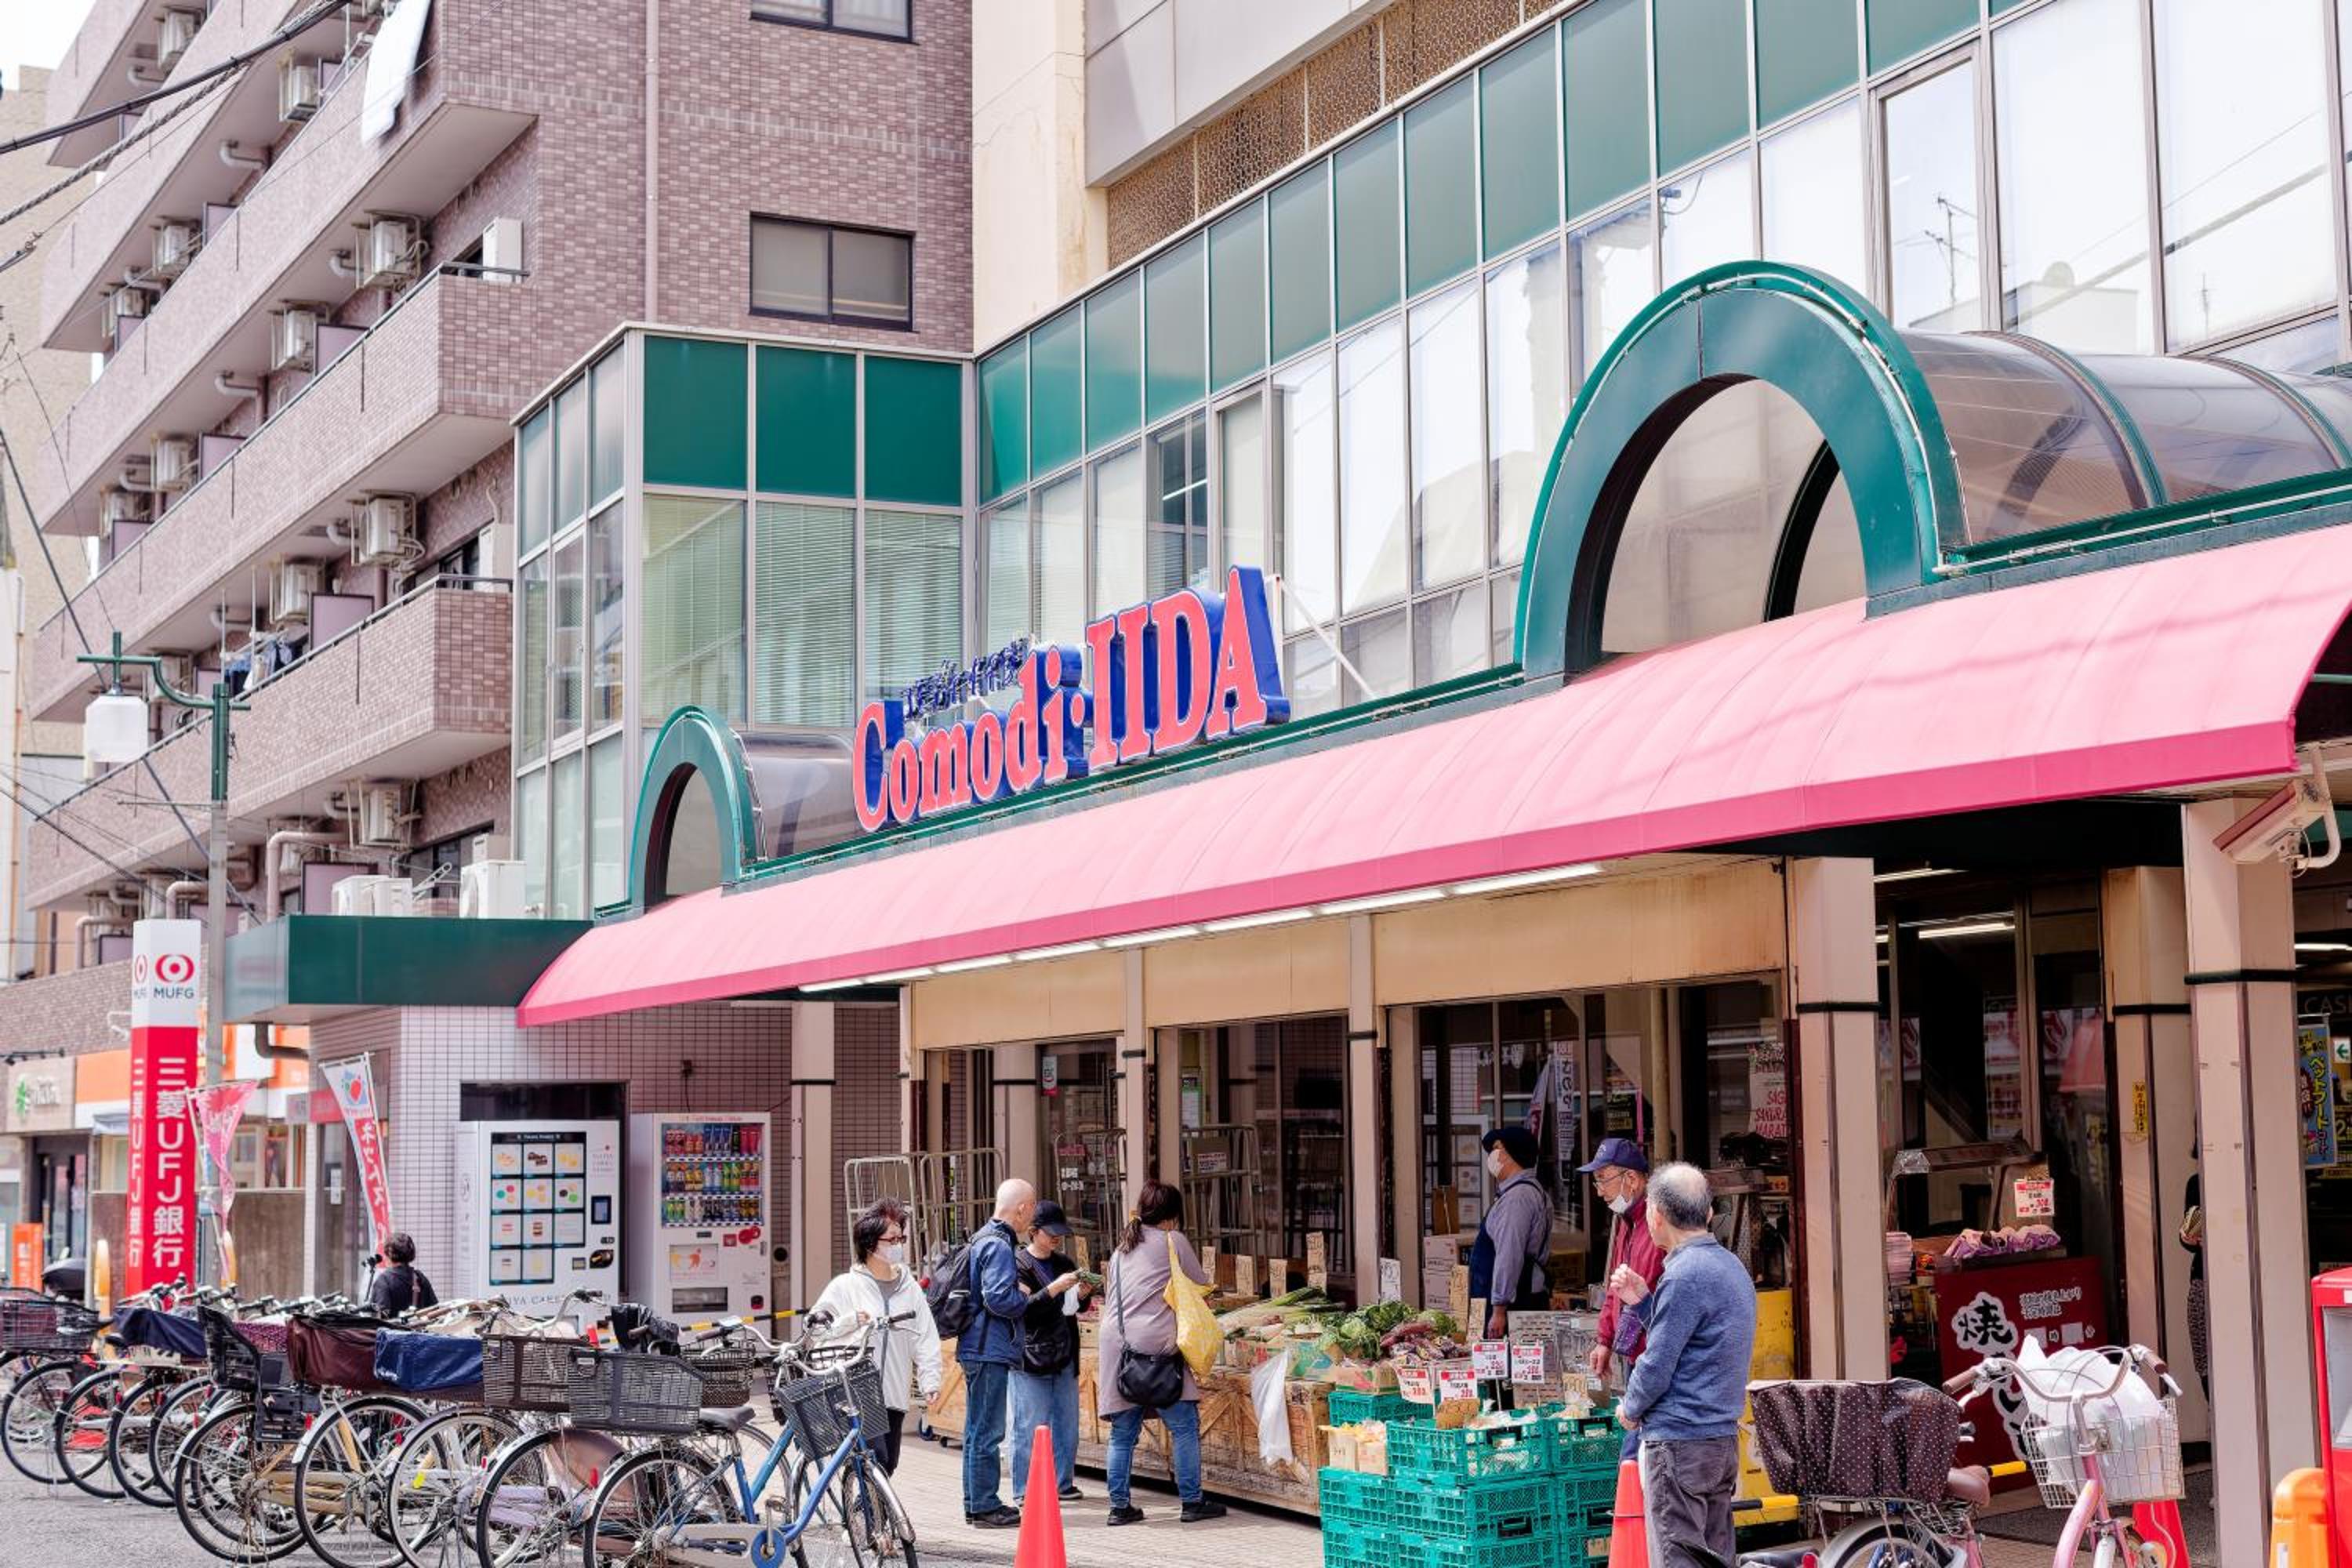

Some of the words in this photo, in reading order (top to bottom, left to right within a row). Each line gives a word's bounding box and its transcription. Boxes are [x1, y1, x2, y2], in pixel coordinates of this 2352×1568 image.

[154, 987, 194, 999] MUFG
[152, 1058, 187, 1268] 三菱UFJ銀行
